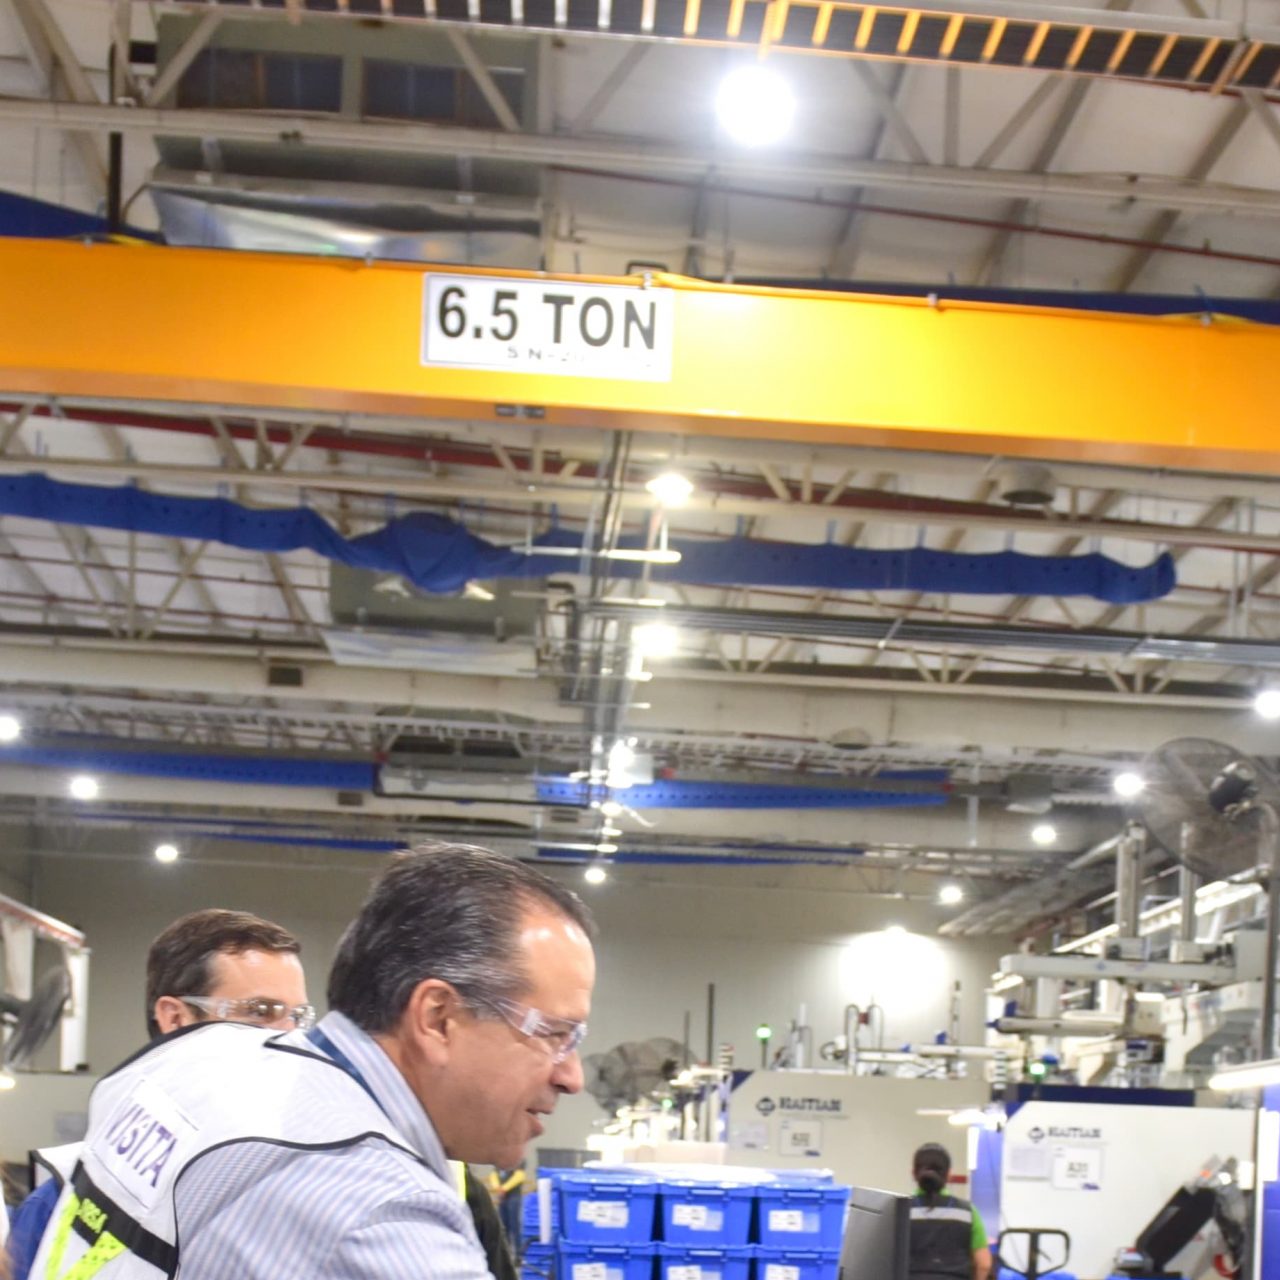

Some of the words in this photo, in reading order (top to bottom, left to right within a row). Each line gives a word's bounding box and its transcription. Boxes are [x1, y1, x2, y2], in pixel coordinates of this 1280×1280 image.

[438, 286, 519, 342] 6.5
[542, 293, 656, 350] TON
[106, 1101, 178, 1188] VISITA
